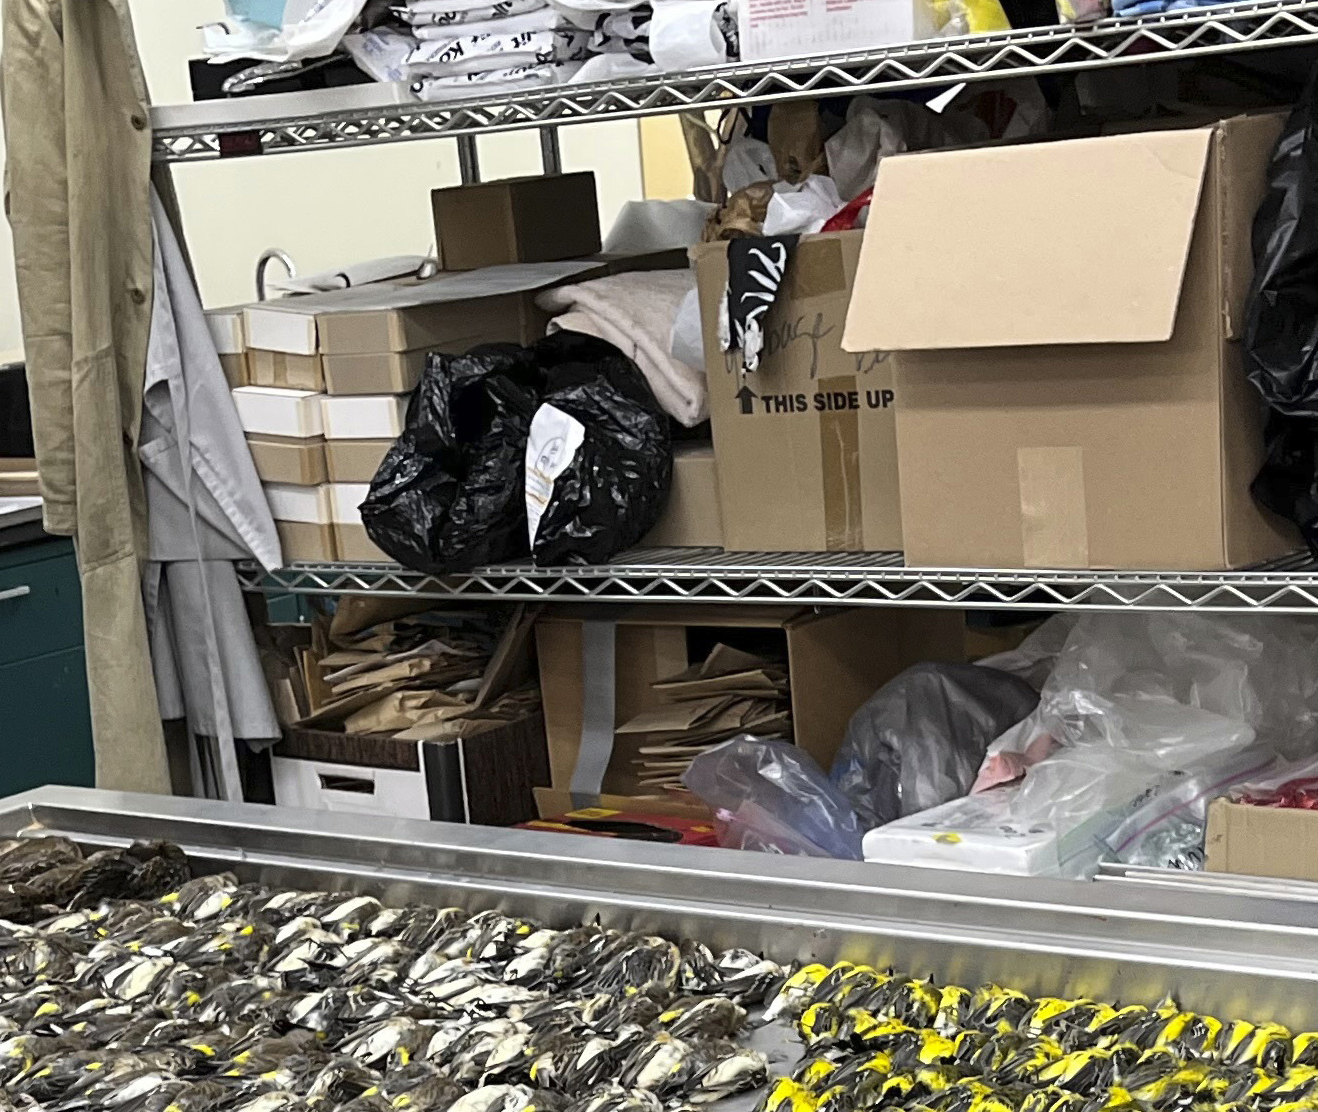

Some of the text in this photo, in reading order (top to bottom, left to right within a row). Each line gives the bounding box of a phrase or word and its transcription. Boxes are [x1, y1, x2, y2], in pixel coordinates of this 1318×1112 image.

[761, 389, 895, 414] THIS SIDE UP
